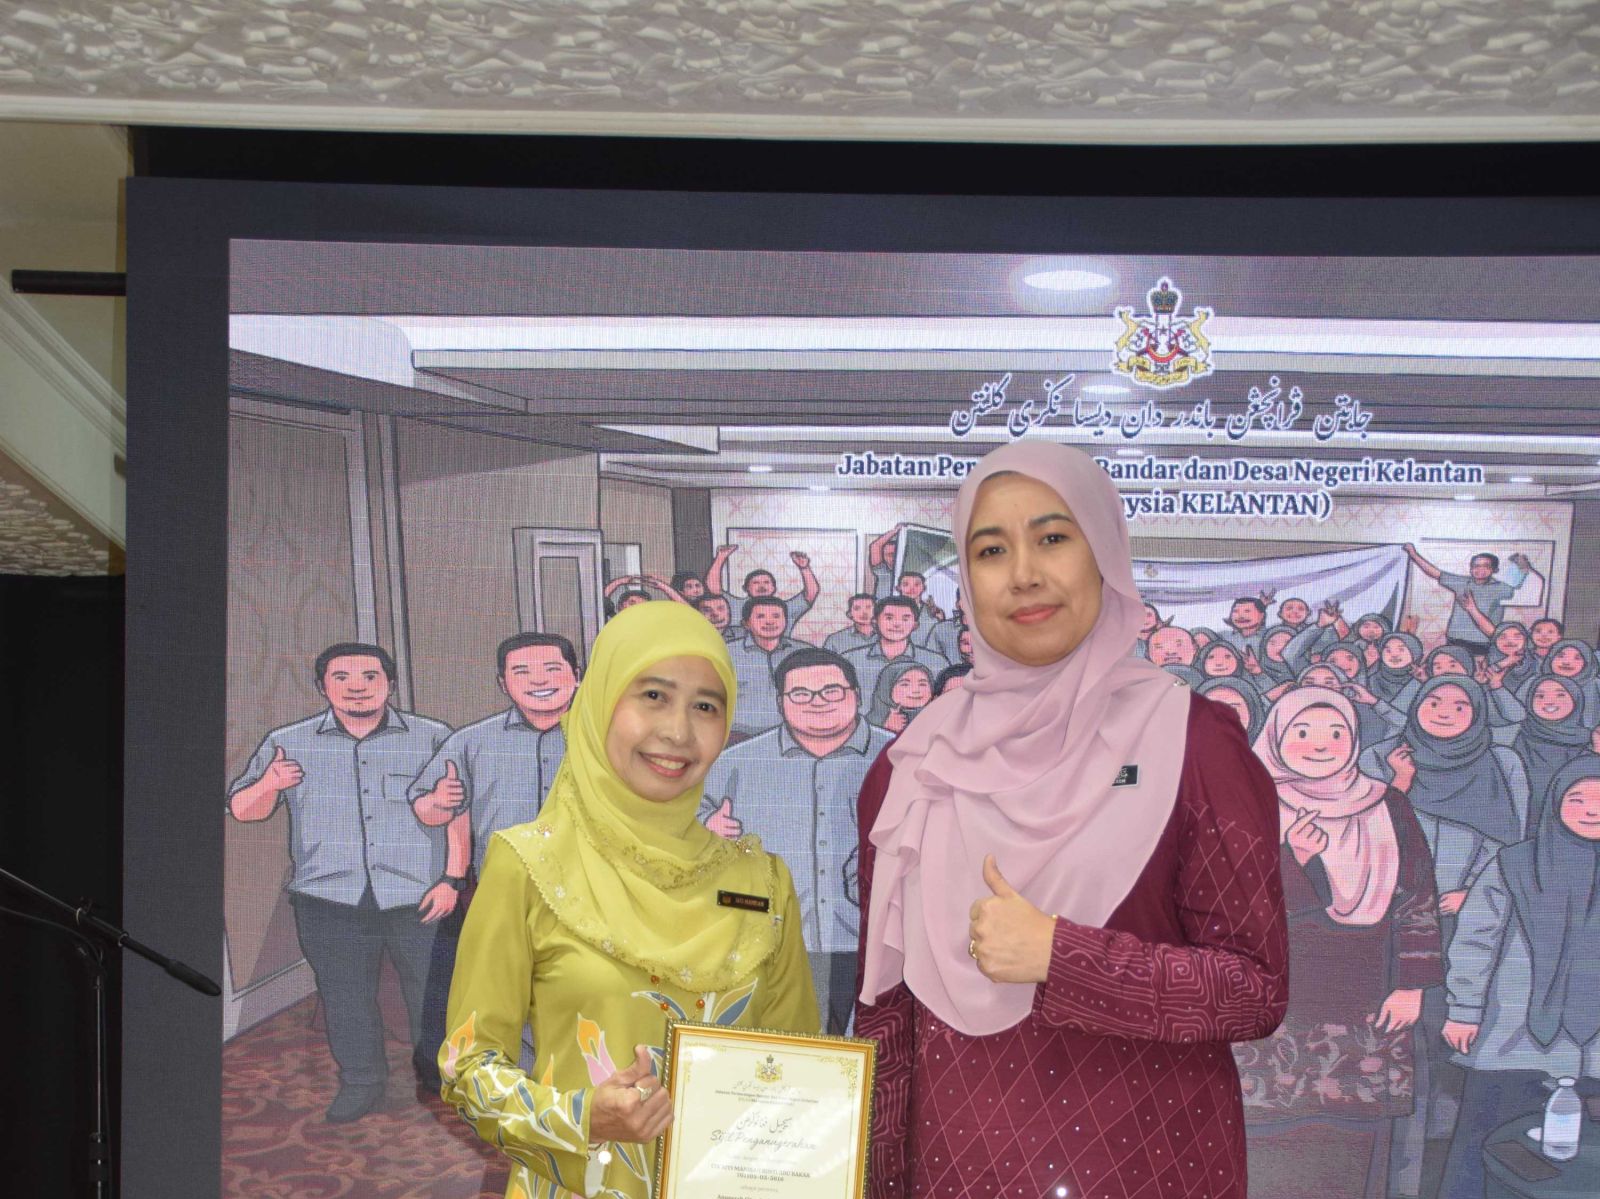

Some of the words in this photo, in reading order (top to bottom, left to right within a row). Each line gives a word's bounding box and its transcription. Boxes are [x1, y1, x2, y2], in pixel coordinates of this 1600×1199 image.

[838, 454, 931, 476] Jabatan
[938, 456, 977, 477] Per
[1184, 457, 1227, 480] dan
[1233, 460, 1287, 481] Desa
[1295, 458, 1370, 487] Negeri
[1375, 460, 1482, 483] Kelantan
[1120, 490, 1174, 519] ysia
[1182, 491, 1331, 519] KELANTAN)
